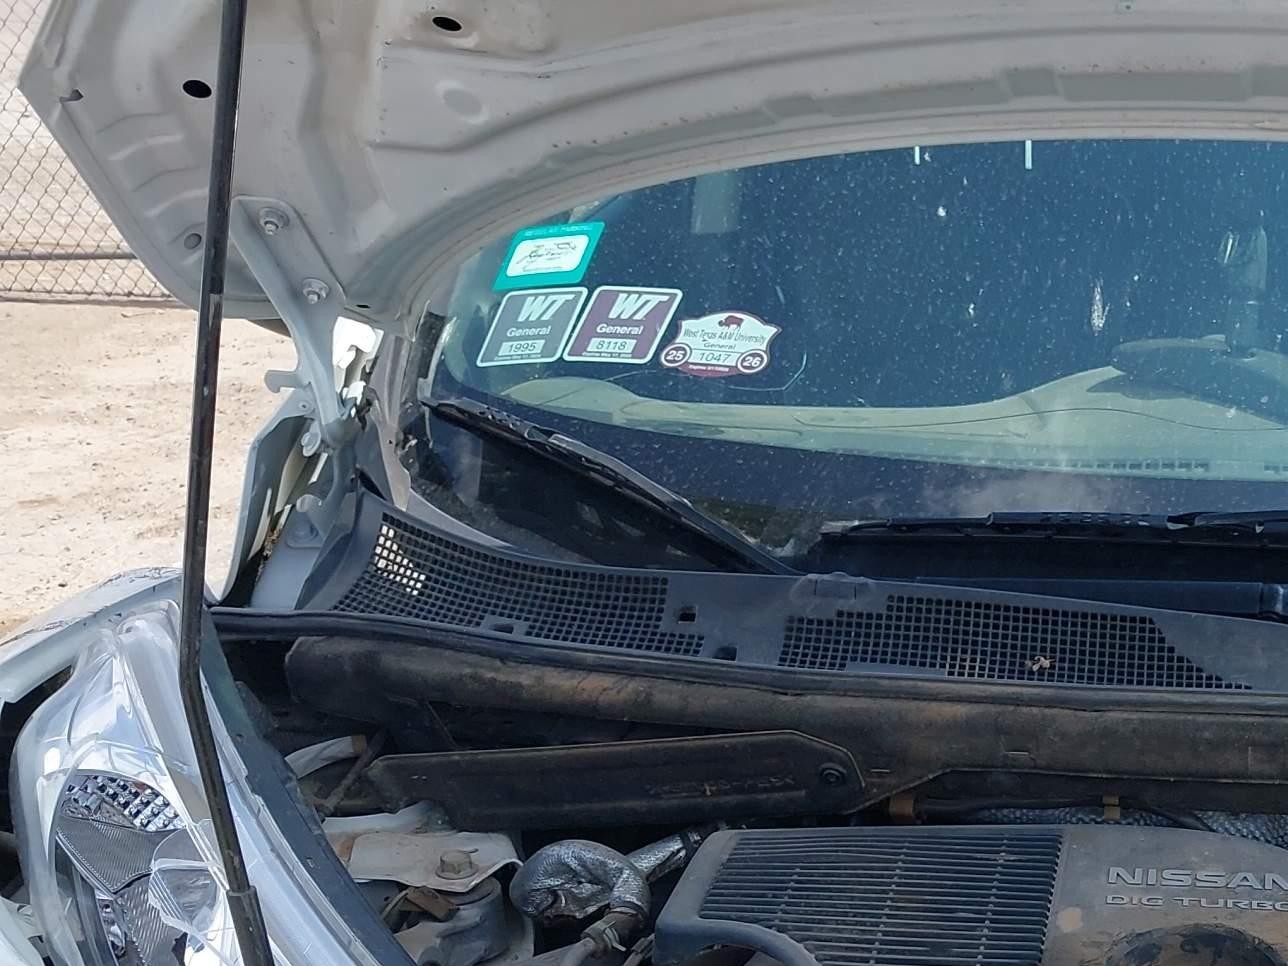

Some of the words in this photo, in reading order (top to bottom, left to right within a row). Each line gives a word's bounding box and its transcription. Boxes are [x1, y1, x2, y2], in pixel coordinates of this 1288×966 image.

[516, 293, 577, 322] WT
[607, 292, 671, 320] WT
[506, 325, 552, 338] General
[596, 322, 645, 336] General
[509, 341, 537, 353] 1995
[596, 339, 628, 351] 8118
[703, 341, 736, 351] General
[665, 349, 685, 362] 25
[699, 352, 732, 363] 1047
[742, 355, 762, 368] 26
[1105, 894, 1164, 907] DIG
